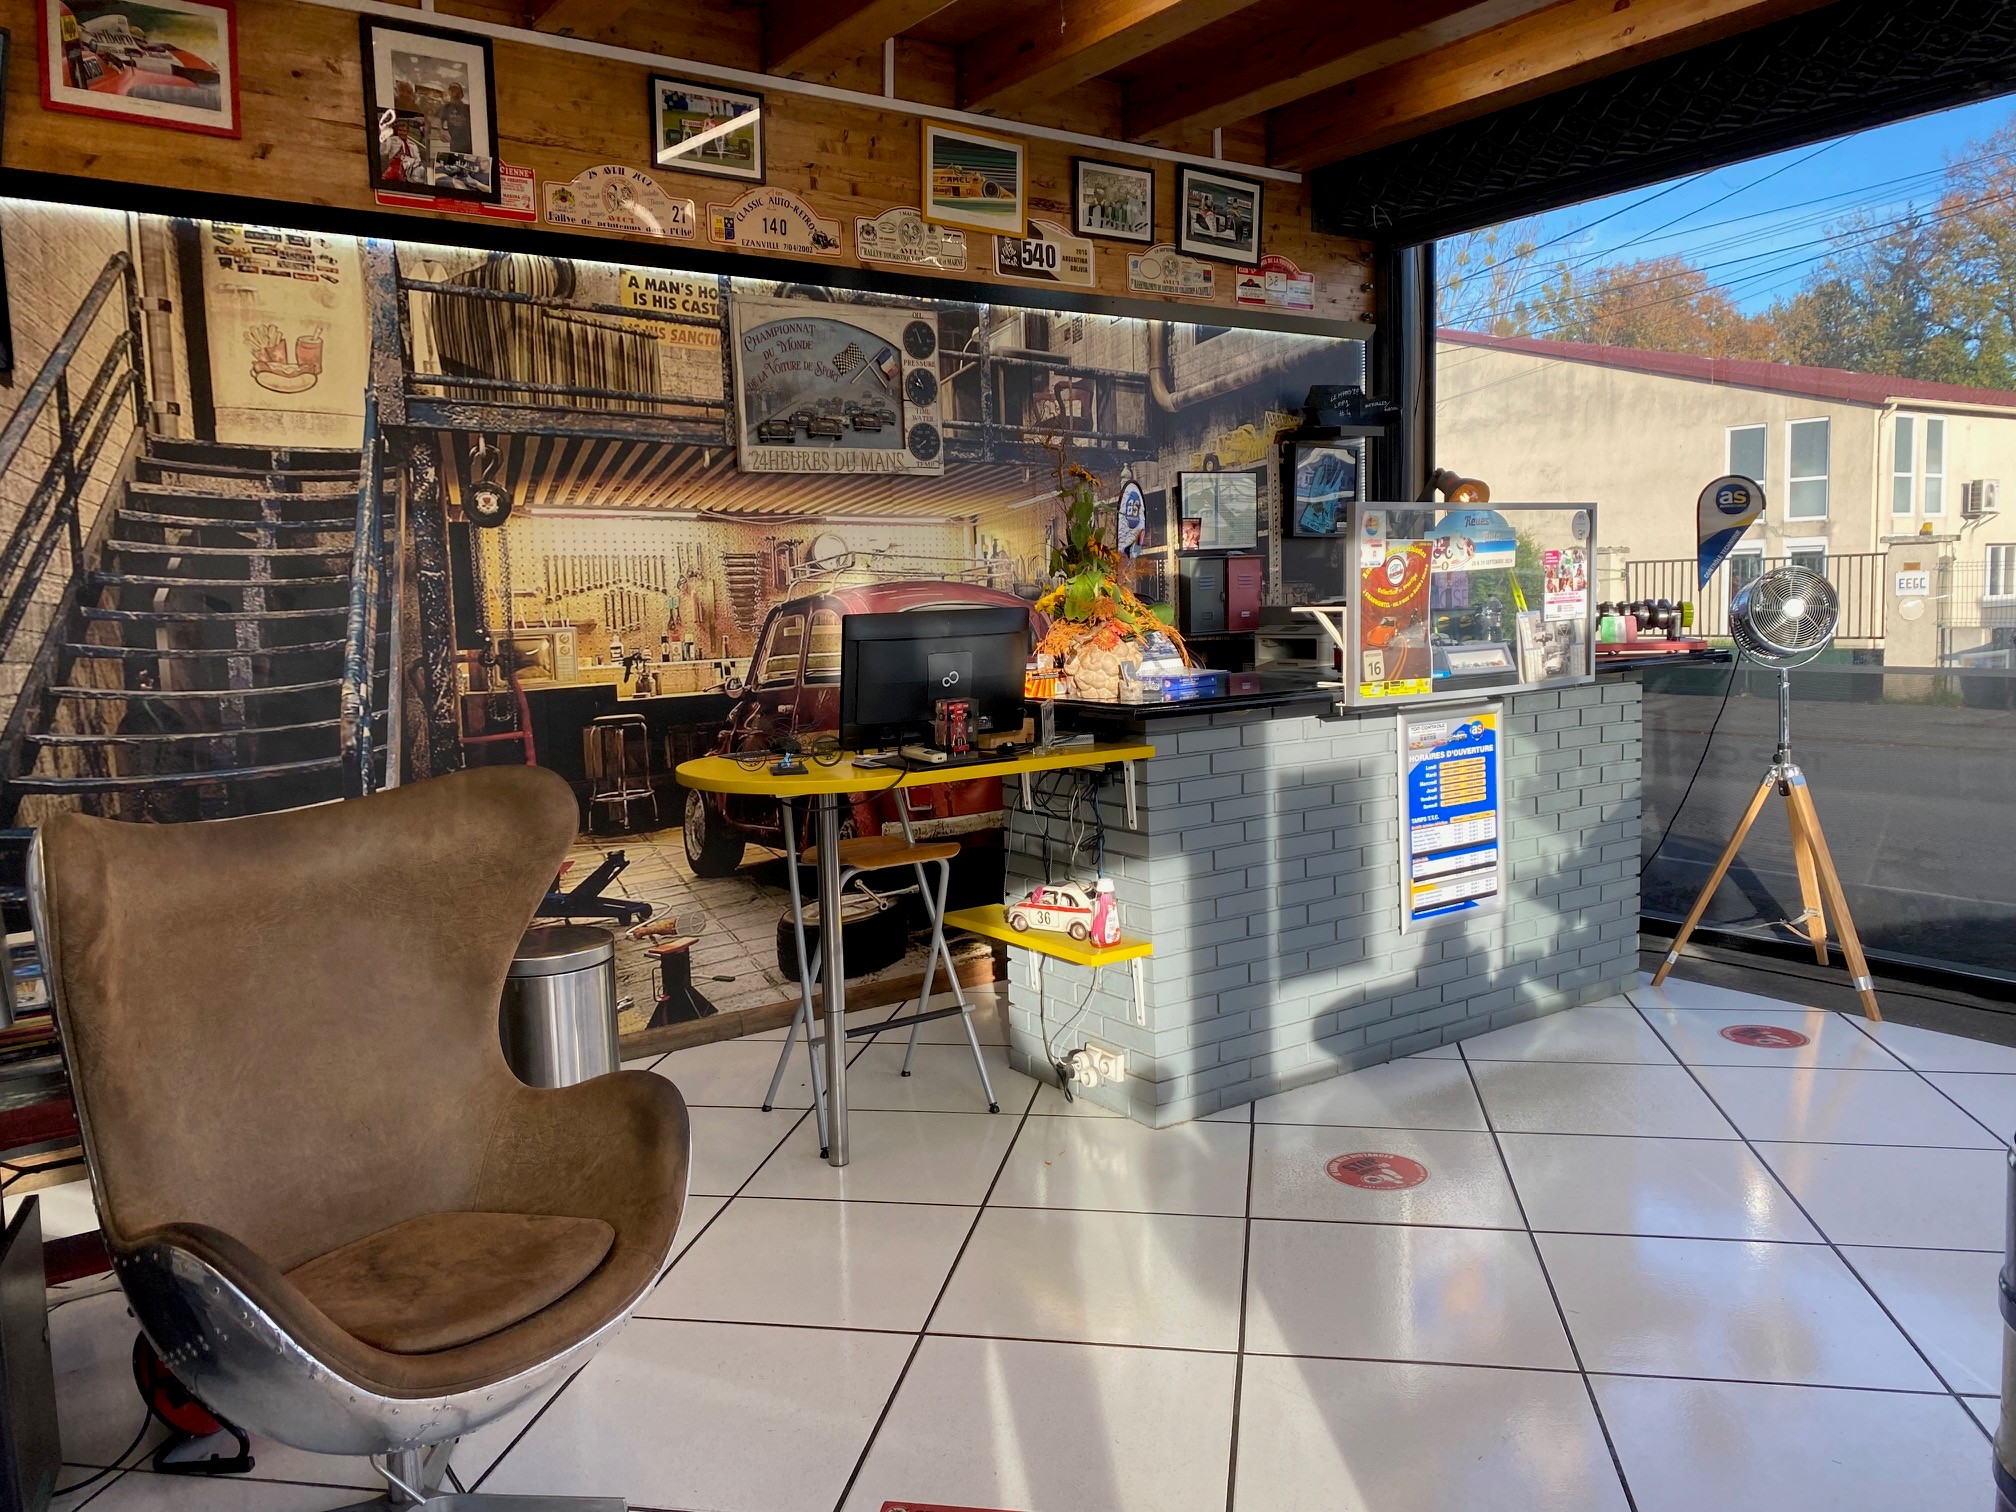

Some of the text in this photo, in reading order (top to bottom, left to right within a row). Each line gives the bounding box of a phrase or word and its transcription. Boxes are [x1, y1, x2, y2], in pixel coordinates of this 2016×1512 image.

[672, 205, 687, 224] 21
[736, 196, 764, 223] CLASSIC
[761, 216, 788, 236] 140
[741, 238, 780, 250] EZANVILLE
[1021, 240, 1056, 269] 540
[1061, 254, 1088, 265] ARGENTINA
[1069, 264, 1088, 274] BOLIVIA
[627, 275, 720, 300] A MAN'S HO
[633, 292, 721, 316] IS HIS CASTL
[744, 323, 816, 353] CHAMPIONNAT
[762, 336, 815, 361] DU MONDE
[765, 357, 802, 377] VOITURE
[803, 361, 815, 372] DE
[814, 360, 842, 384] SPORT
[903, 359, 936, 368] PRESSURE
[912, 414, 935, 423] WATER
[915, 407, 931, 416] TIME
[834, 451, 858, 472] DU
[860, 452, 906, 474] MANS
[1718, 490, 1748, 505] as
[1367, 661, 1382, 677] 16
[1471, 724, 1483, 735] as
[1408, 744, 1495, 764] HORAIRES D'OUVERTURE
[1036, 910, 1052, 925] 36
